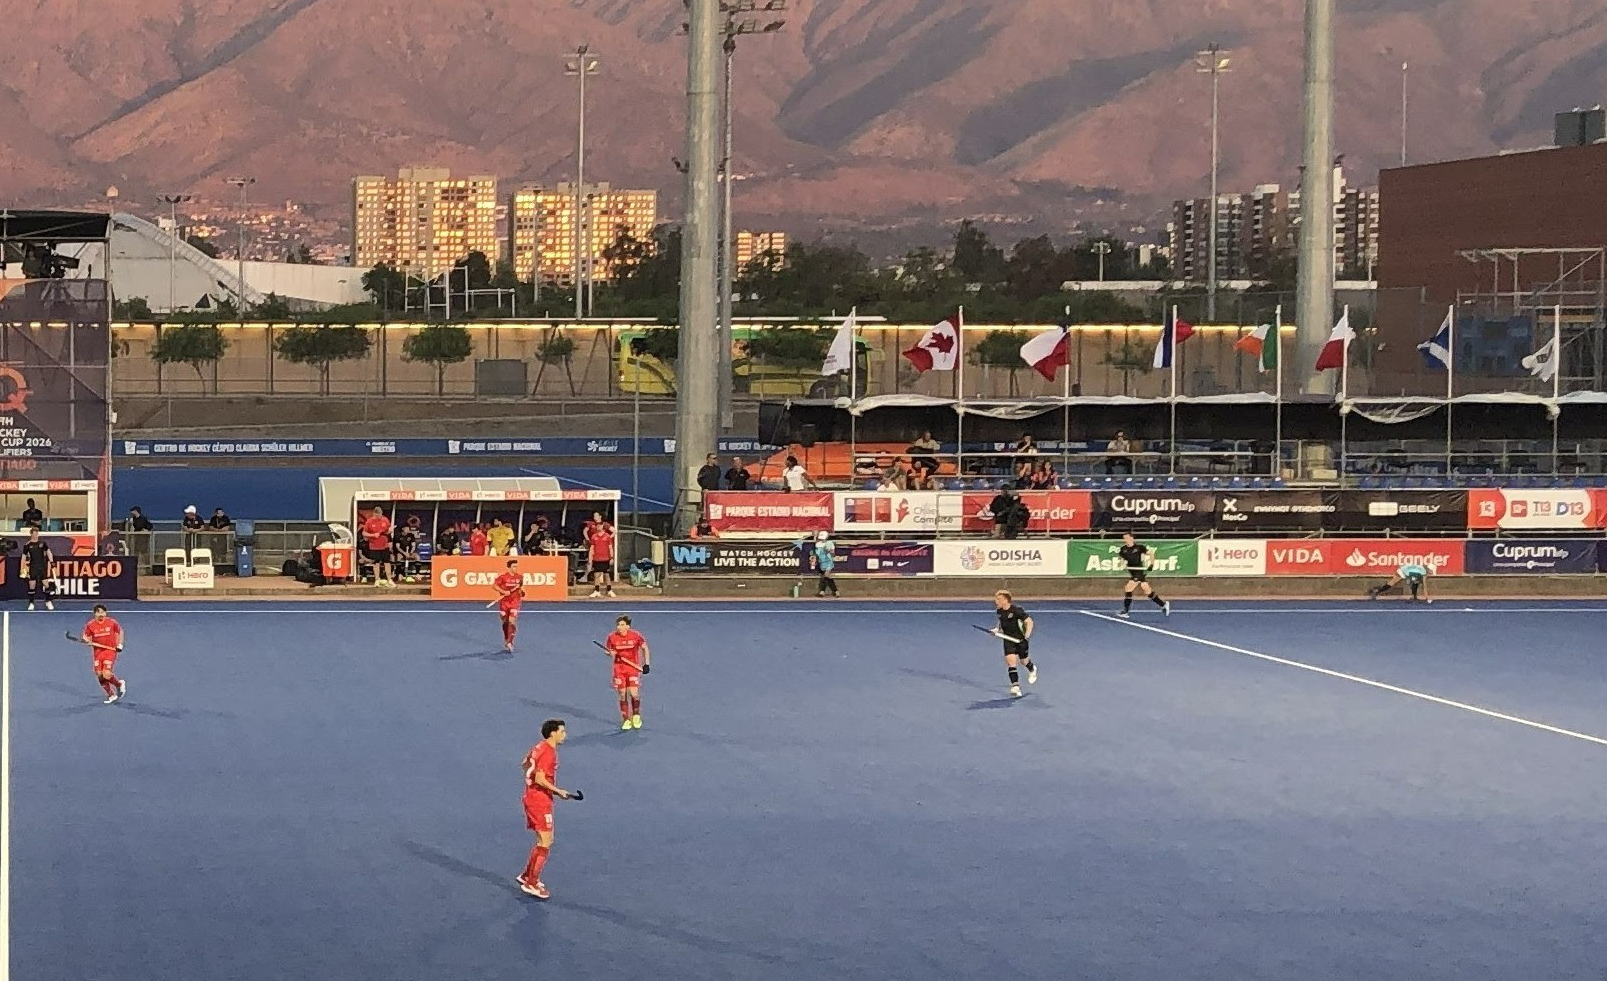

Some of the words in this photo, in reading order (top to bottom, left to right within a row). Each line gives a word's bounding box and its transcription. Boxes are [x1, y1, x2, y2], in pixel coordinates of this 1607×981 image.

[1, 437, 23, 447] CUP
[26, 437, 52, 447] 2026
[391, 492, 414, 500] VIDA
[726, 506, 756, 517] PARQUE
[758, 506, 790, 517] ESTADIO
[792, 506, 831, 518] NACIONAL
[1111, 496, 1181, 514] Cuprum
[1556, 502, 1584, 516] D13
[988, 550, 1042, 561] ODISHA
[1224, 549, 1258, 560] Hero
[1272, 548, 1324, 564] VIDA
[1493, 544, 1556, 561] Cuprum
[326, 554, 342, 570] G
[714, 558, 736, 568] LIVE
[738, 558, 756, 568] THE
[759, 557, 800, 568] ACTION
[1368, 552, 1450, 568] Santander
[48, 560, 122, 578] NTIAGO
[440, 568, 458, 588] G
[464, 572, 556, 586] GATADE
